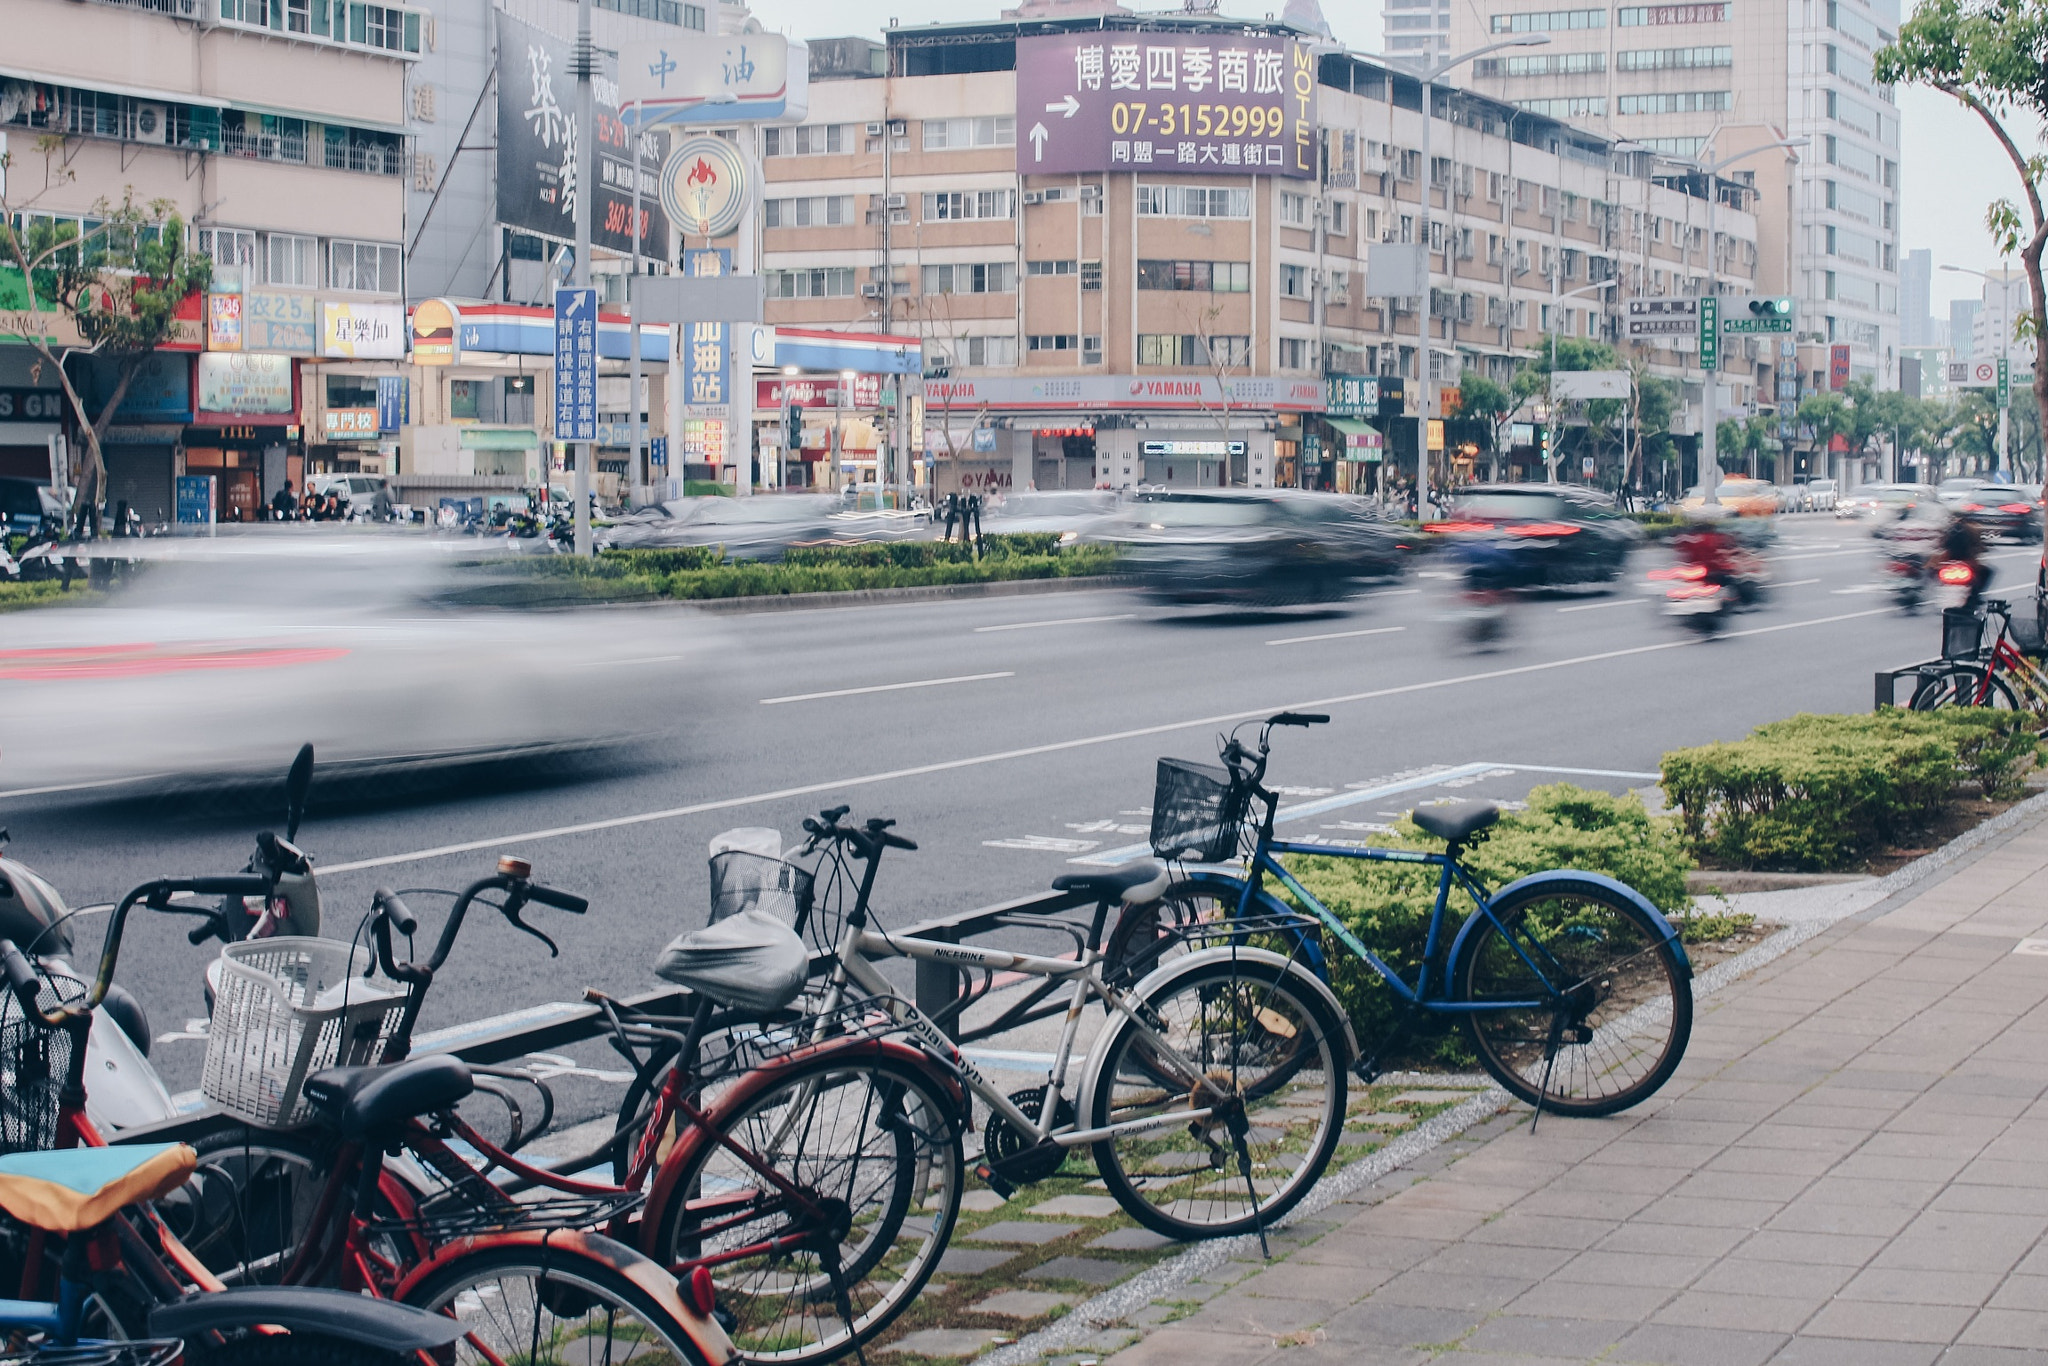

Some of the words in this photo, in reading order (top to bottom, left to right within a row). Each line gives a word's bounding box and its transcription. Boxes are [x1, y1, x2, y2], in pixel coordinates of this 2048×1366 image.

[648, 44, 756, 90] 中油
[1074, 44, 1285, 95] 博愛四季商旅
[1111, 102, 1284, 138] 07-3152999
[1293, 44, 1313, 171] MOTEL
[1111, 140, 1284, 167] 同盟一路大連街口
[336, 317, 389, 343] 星樂加
[692, 252, 722, 404] 博加油站
[558, 318, 574, 439] 請由慢車道右轉
[577, 318, 593, 439] 右轉同盟路車輛
[925, 383, 975, 397] YAMAHA
[1146, 381, 1202, 397] YAMAHA
[1297, 385, 1318, 398] YAMAHA
[933, 947, 987, 963] NICEBIKE
